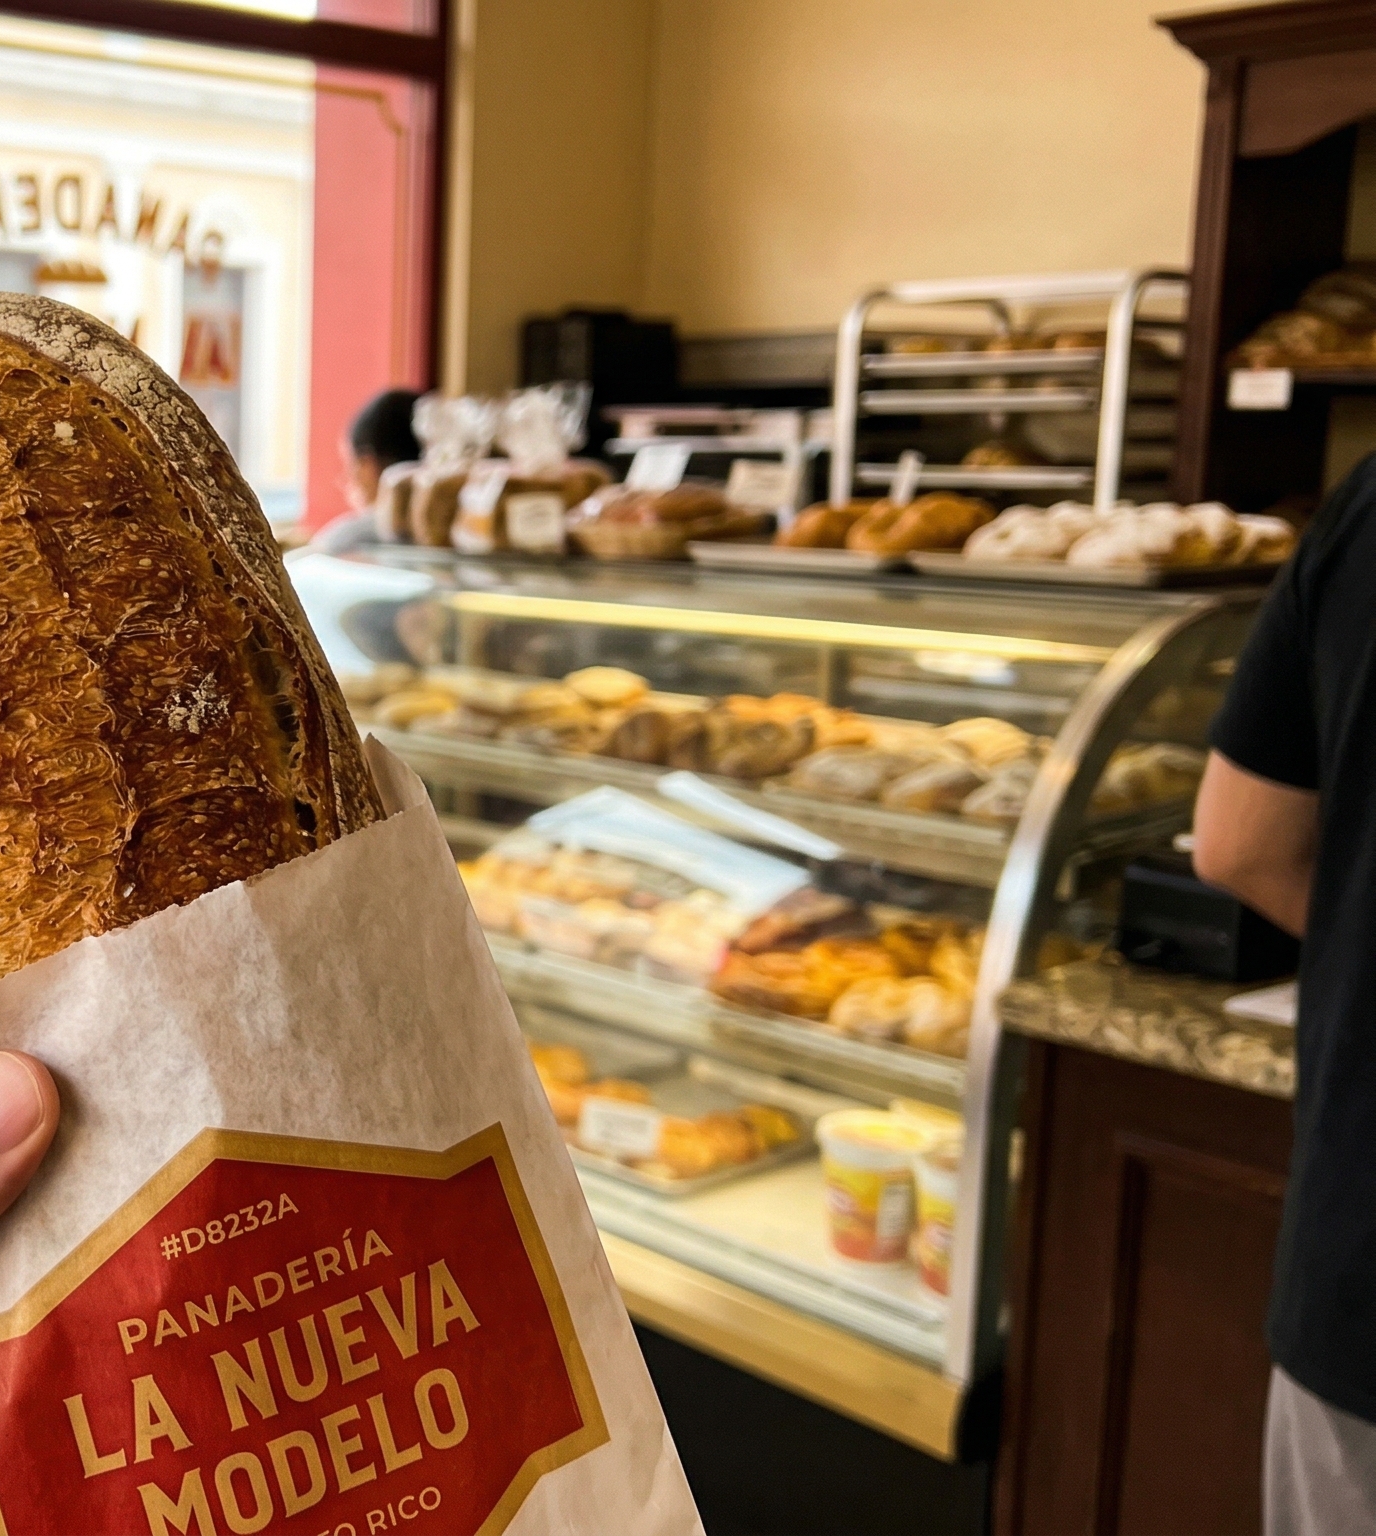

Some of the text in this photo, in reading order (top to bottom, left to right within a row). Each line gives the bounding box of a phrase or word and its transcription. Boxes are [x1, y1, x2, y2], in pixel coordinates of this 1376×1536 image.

[159, 1192, 300, 1261] #D8232A
[117, 1228, 393, 1356] PANADERÍA
[62, 1258, 481, 1479] LA NUEVA
[136, 1367, 470, 1536] MODELO
[365, 1486, 442, 1535] RICO
